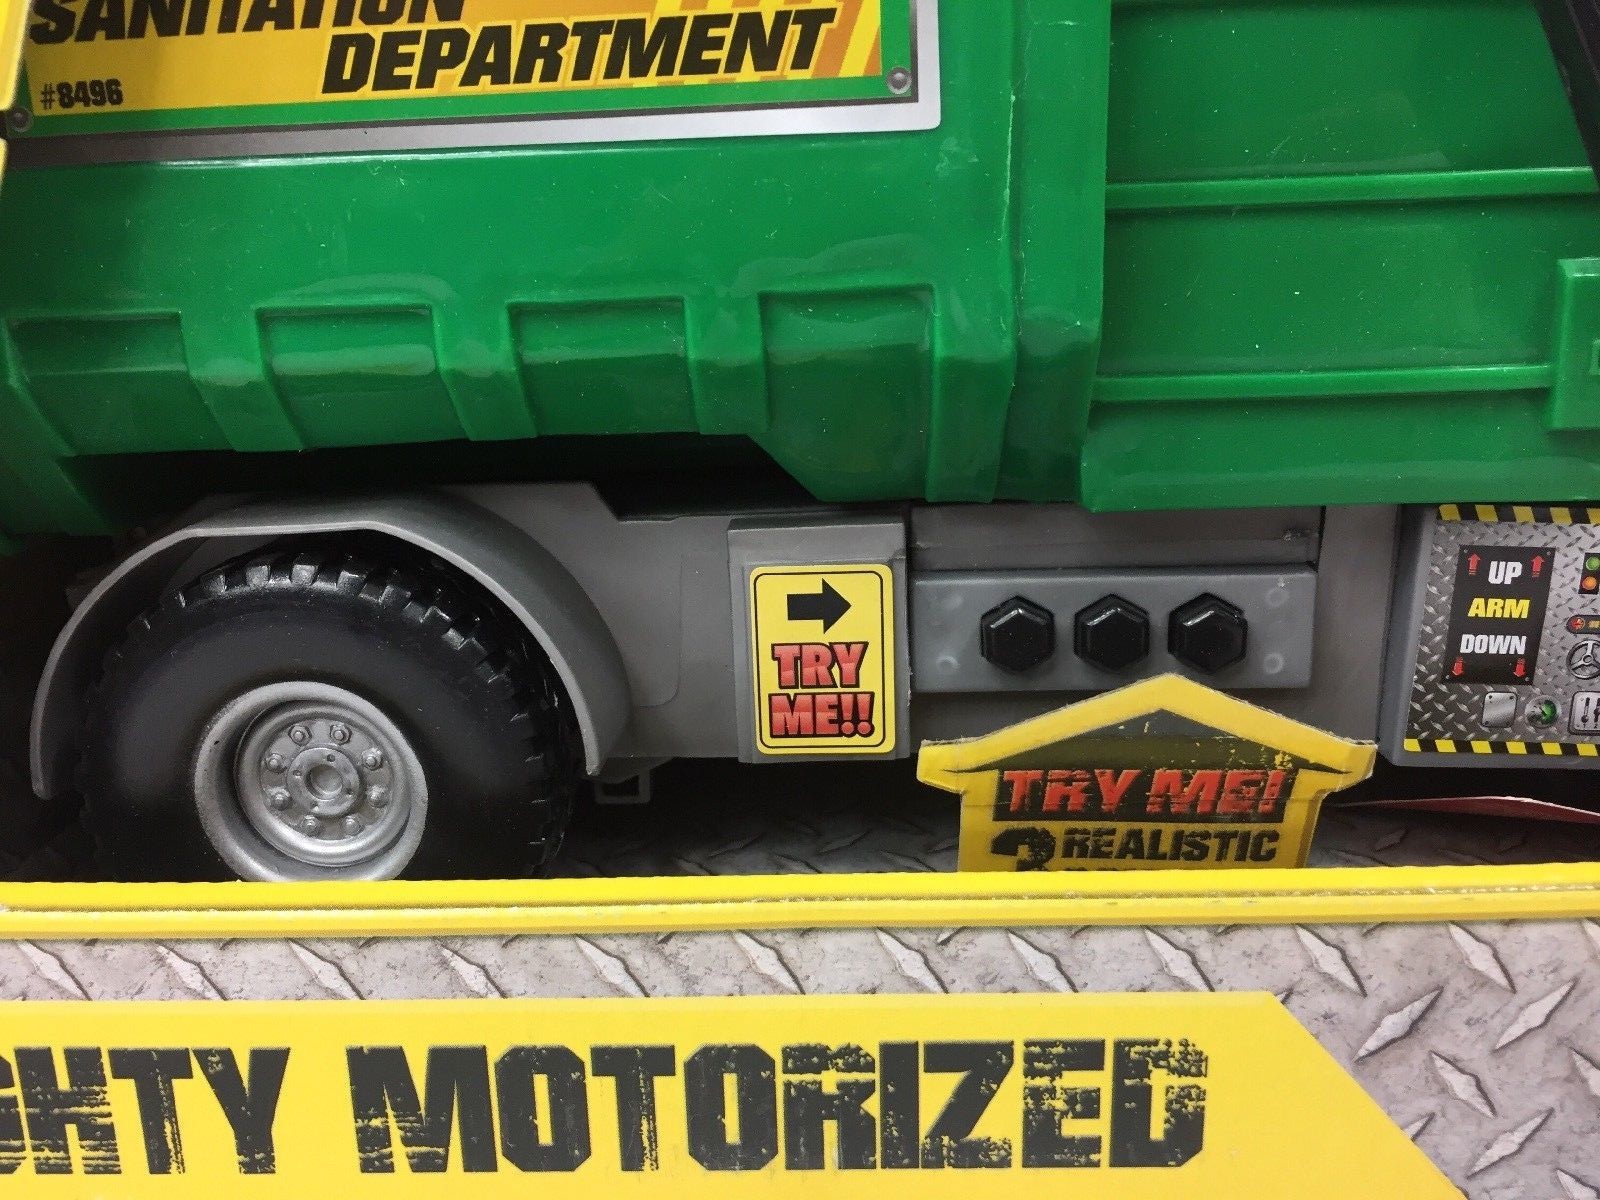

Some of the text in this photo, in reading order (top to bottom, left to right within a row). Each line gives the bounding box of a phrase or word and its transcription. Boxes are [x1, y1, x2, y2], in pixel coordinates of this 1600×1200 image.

[321, 8, 836, 95] DEPARTMENT
[40, 78, 123, 110] #8496
[1487, 561, 1523, 585] UP
[1467, 597, 1531, 619] ARM
[1459, 634, 1527, 655] DOWN
[771, 641, 869, 689] TRY
[768, 691, 875, 738] ME!!
[1002, 769, 1287, 815] TRY ME!
[1061, 827, 1279, 862] REALISTIC
[345, 1038, 1208, 1174] MOTORIZED
